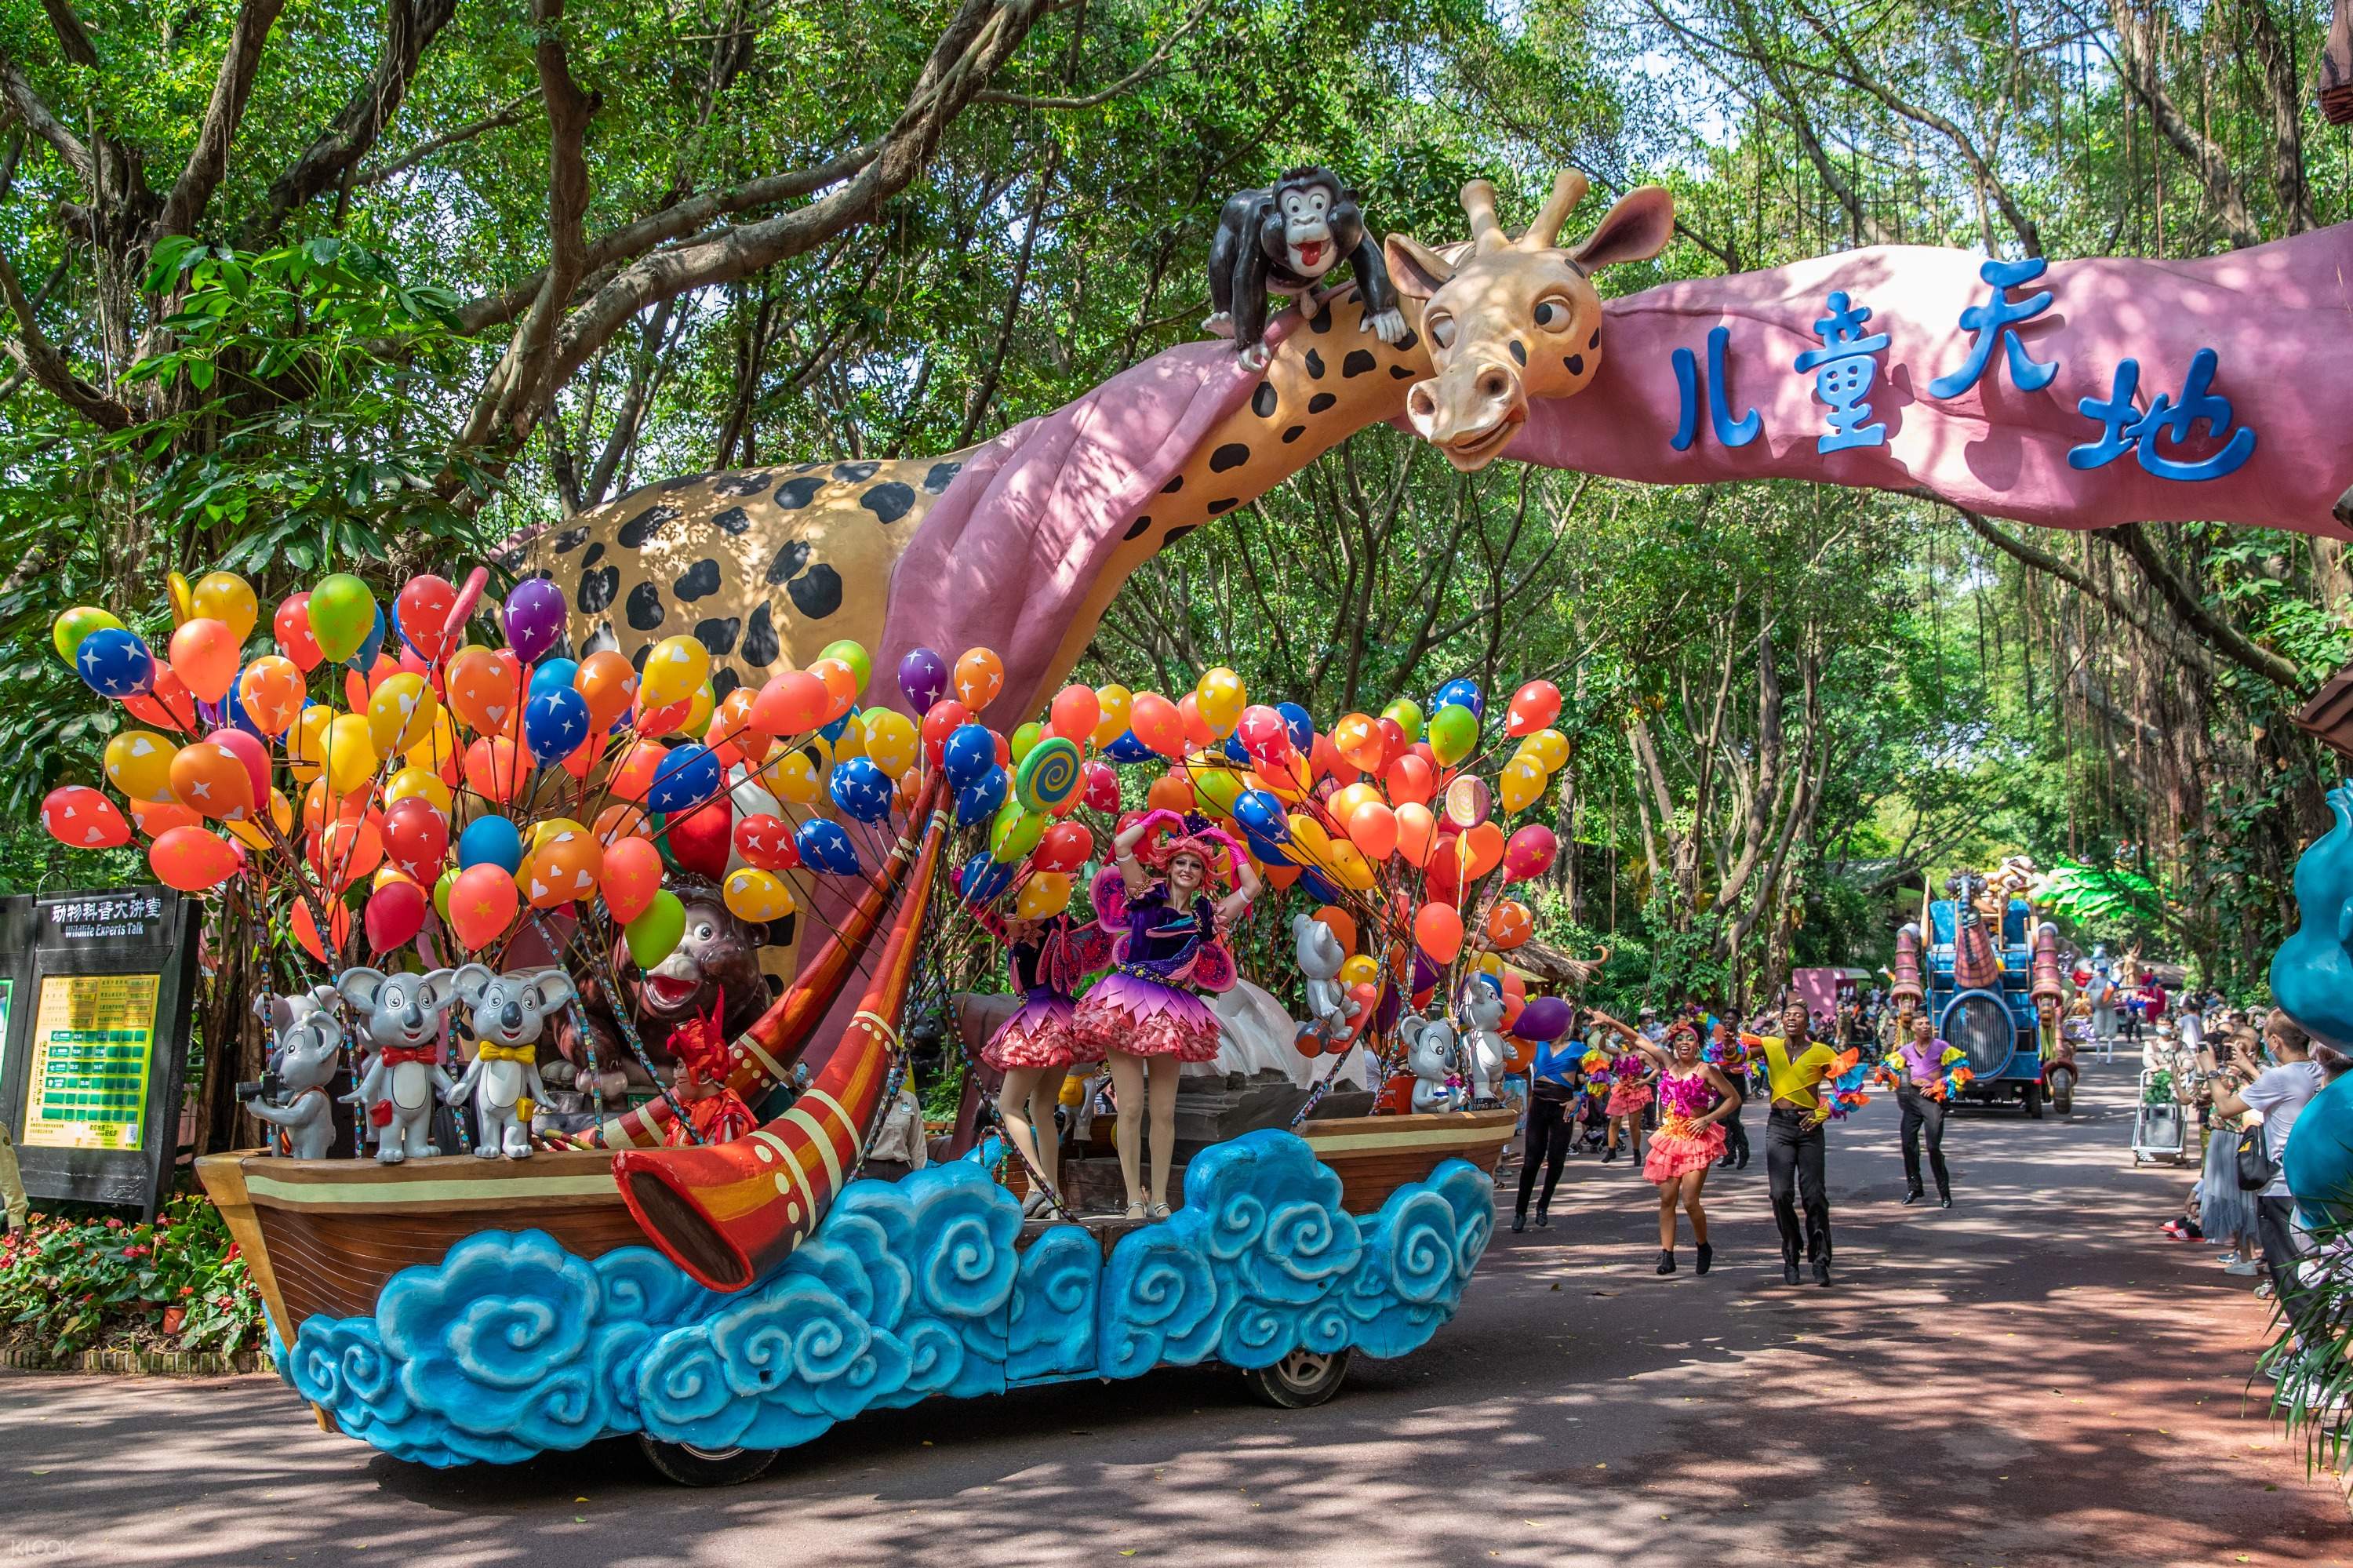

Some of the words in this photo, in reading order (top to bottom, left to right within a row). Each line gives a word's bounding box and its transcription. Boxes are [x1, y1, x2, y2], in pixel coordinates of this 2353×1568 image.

[1671, 256, 2257, 481] 儿童天地
[65, 924, 94, 938] Wildlife
[96, 923, 125, 937] Experts
[127, 922, 144, 935] Talk
